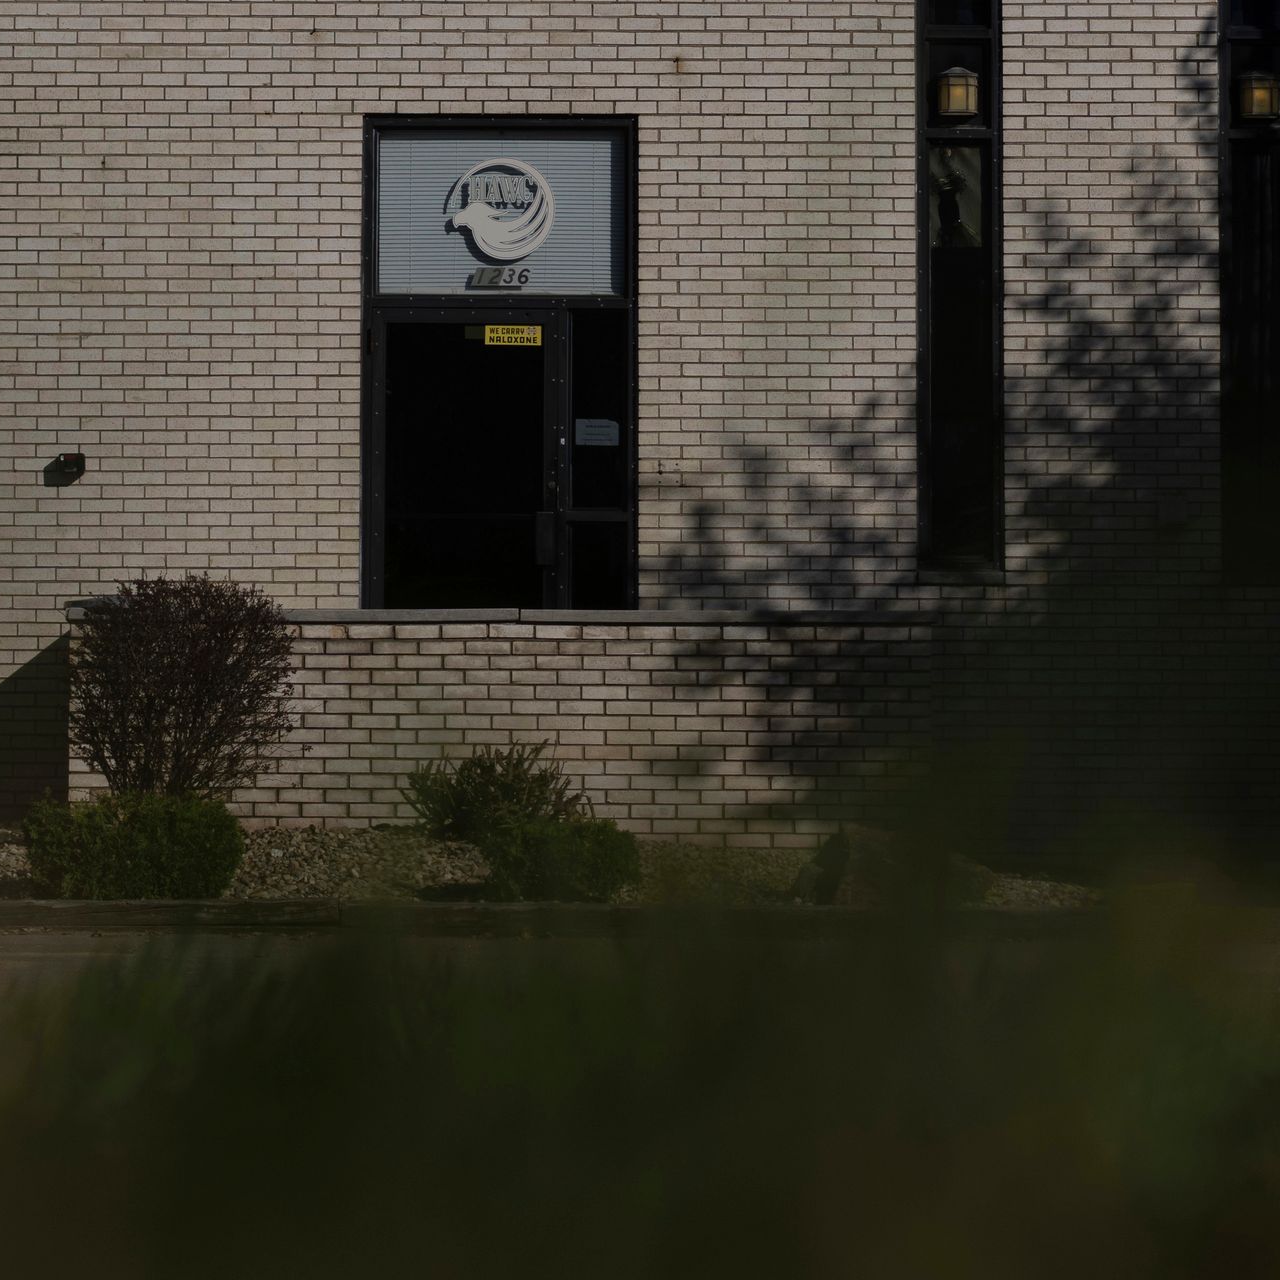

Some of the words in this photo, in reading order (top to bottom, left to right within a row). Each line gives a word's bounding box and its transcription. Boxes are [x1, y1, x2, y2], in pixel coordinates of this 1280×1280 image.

[469, 175, 534, 203] HAWC
[477, 268, 531, 285] 1236
[501, 327, 525, 335] CARRY
[488, 335, 538, 344] NALOXONE
